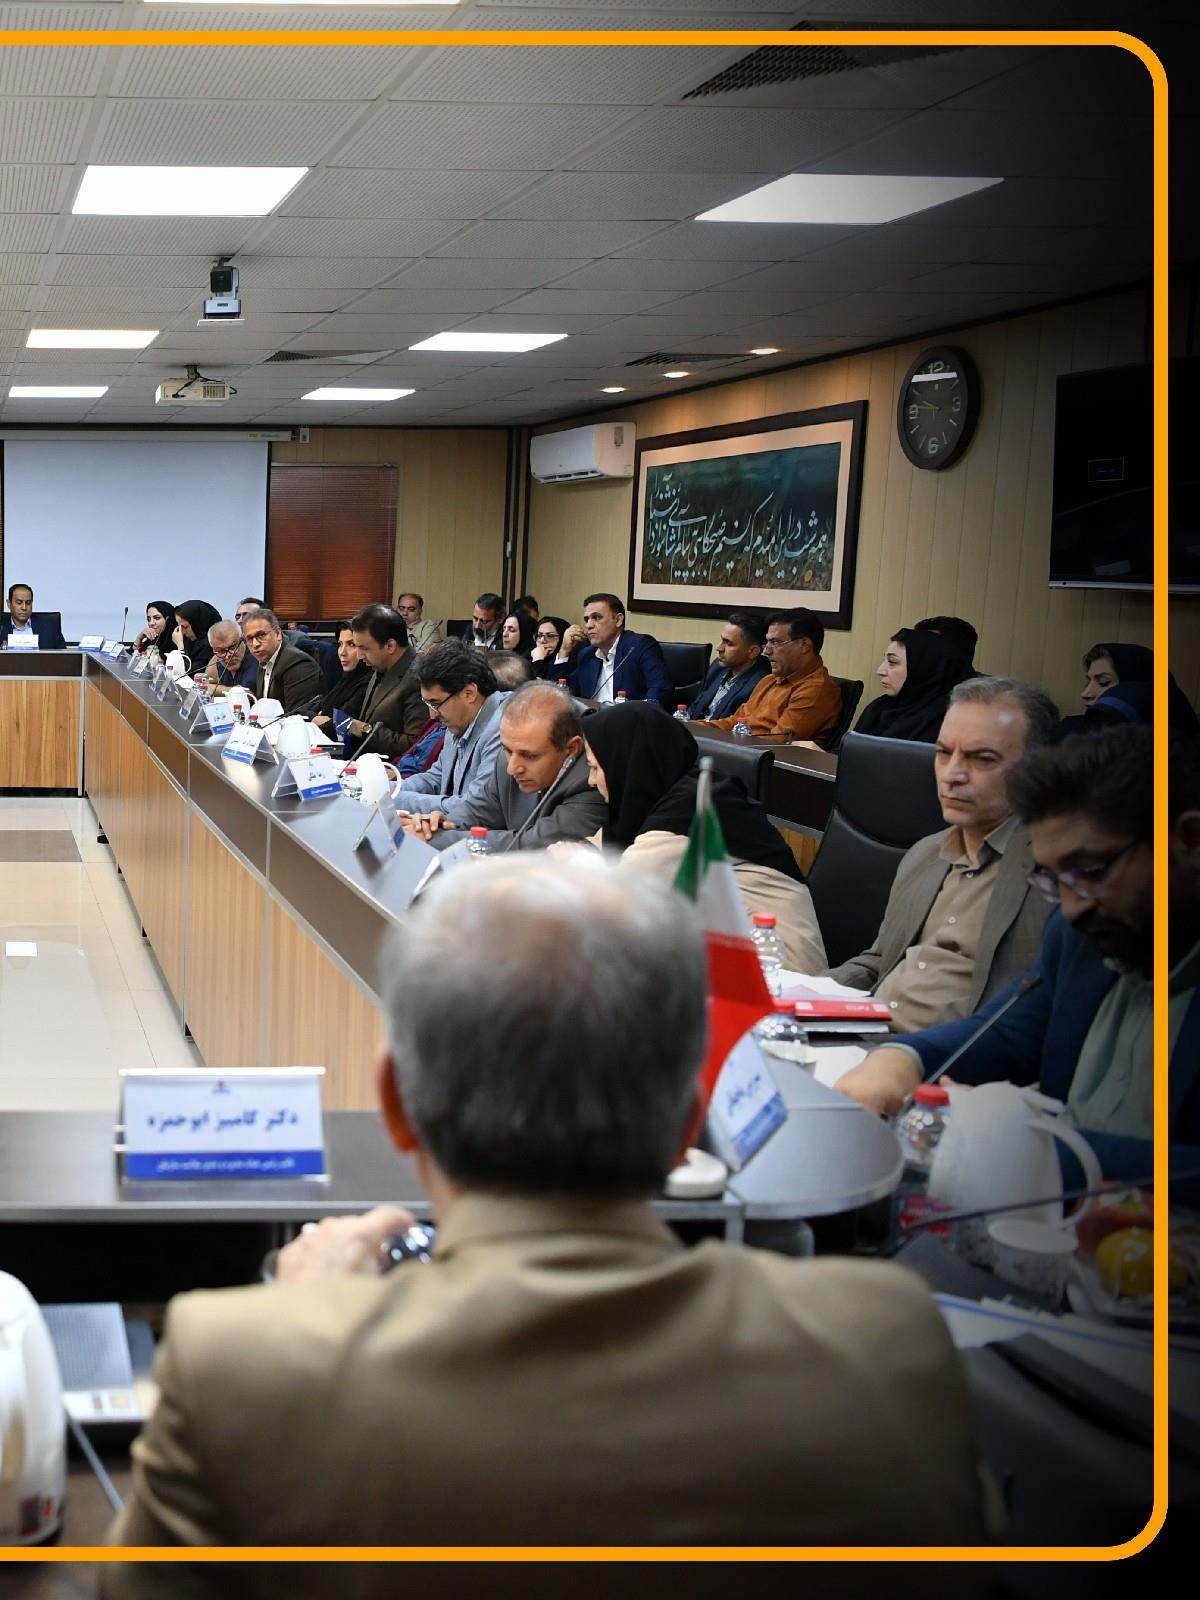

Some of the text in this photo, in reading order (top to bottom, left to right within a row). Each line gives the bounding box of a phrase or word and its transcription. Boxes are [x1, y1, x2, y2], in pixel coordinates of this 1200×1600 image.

[928, 361, 945, 374] 12
[951, 396, 962, 412] 3
[927, 436, 940, 454] 6
[264, 1109, 298, 1132] دکتر
